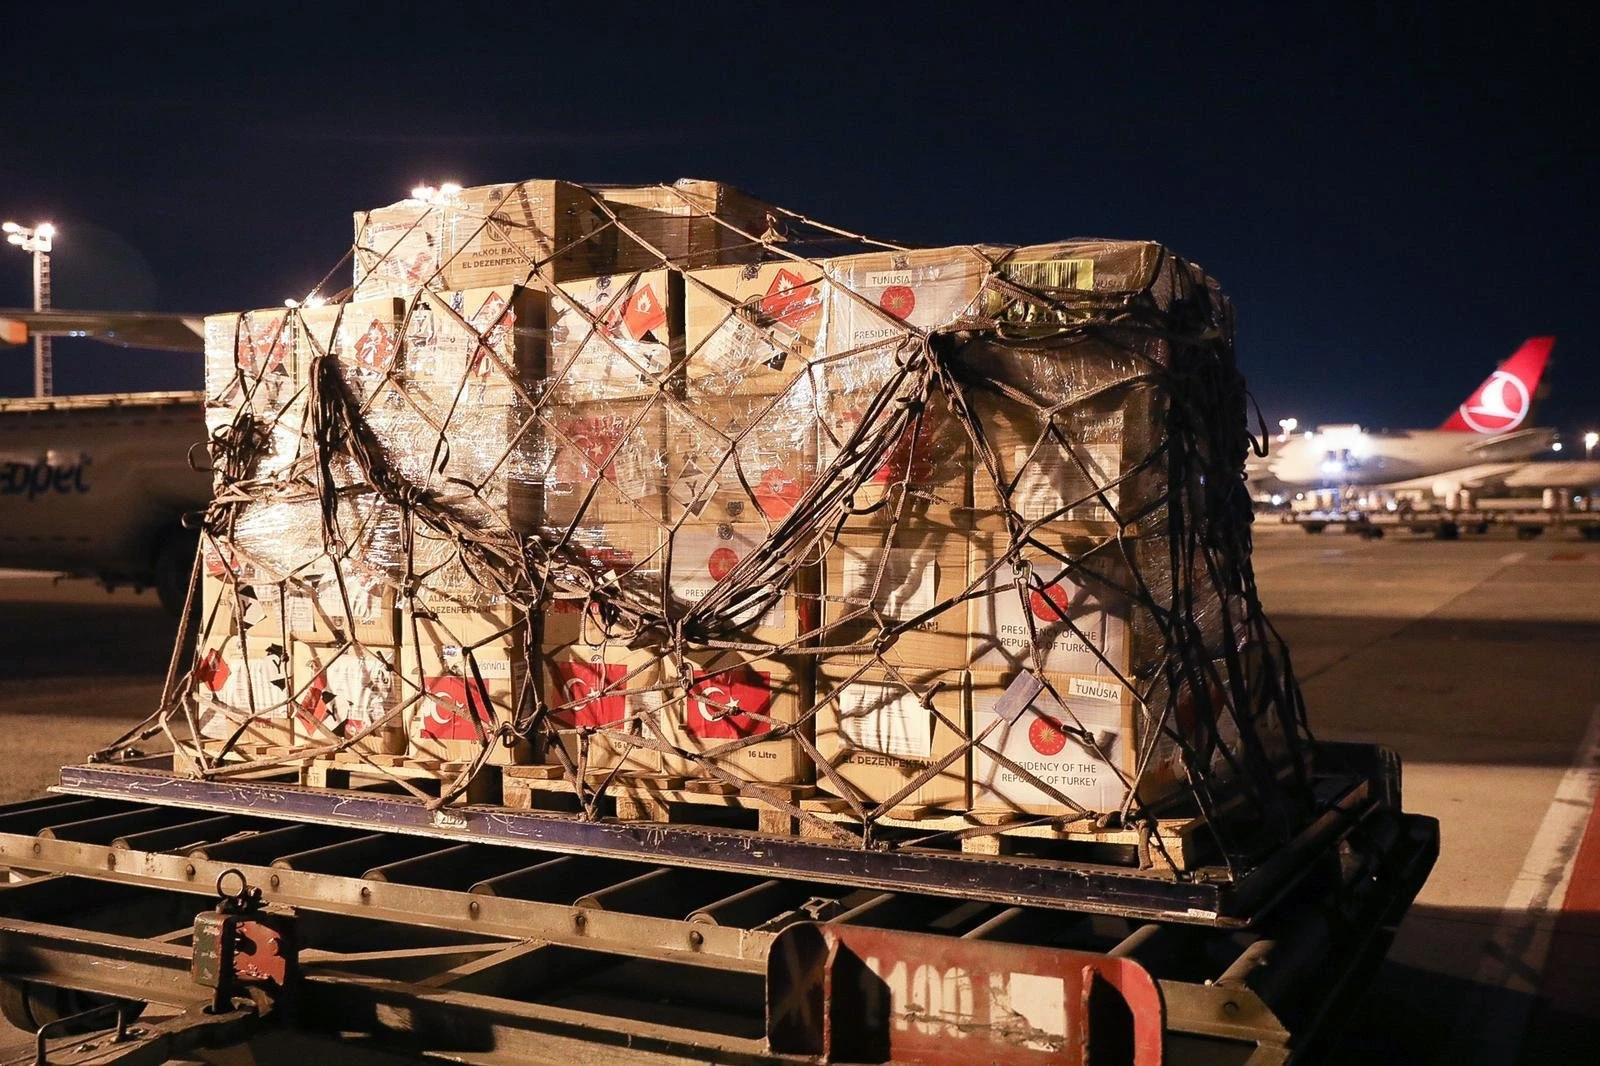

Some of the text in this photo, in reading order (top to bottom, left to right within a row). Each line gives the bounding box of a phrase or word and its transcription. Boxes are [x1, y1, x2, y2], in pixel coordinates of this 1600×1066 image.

[872, 276, 911, 284] TUNUSIA
[1061, 630, 1074, 639] OF
[1076, 684, 1118, 699] TUNUSIA
[748, 750, 777, 759] 16 Litre
[1062, 763, 1075, 772] OF
[1079, 764, 1096, 774] THE
[1047, 775, 1059, 785] OF
[1062, 776, 1097, 787] TURKEY
